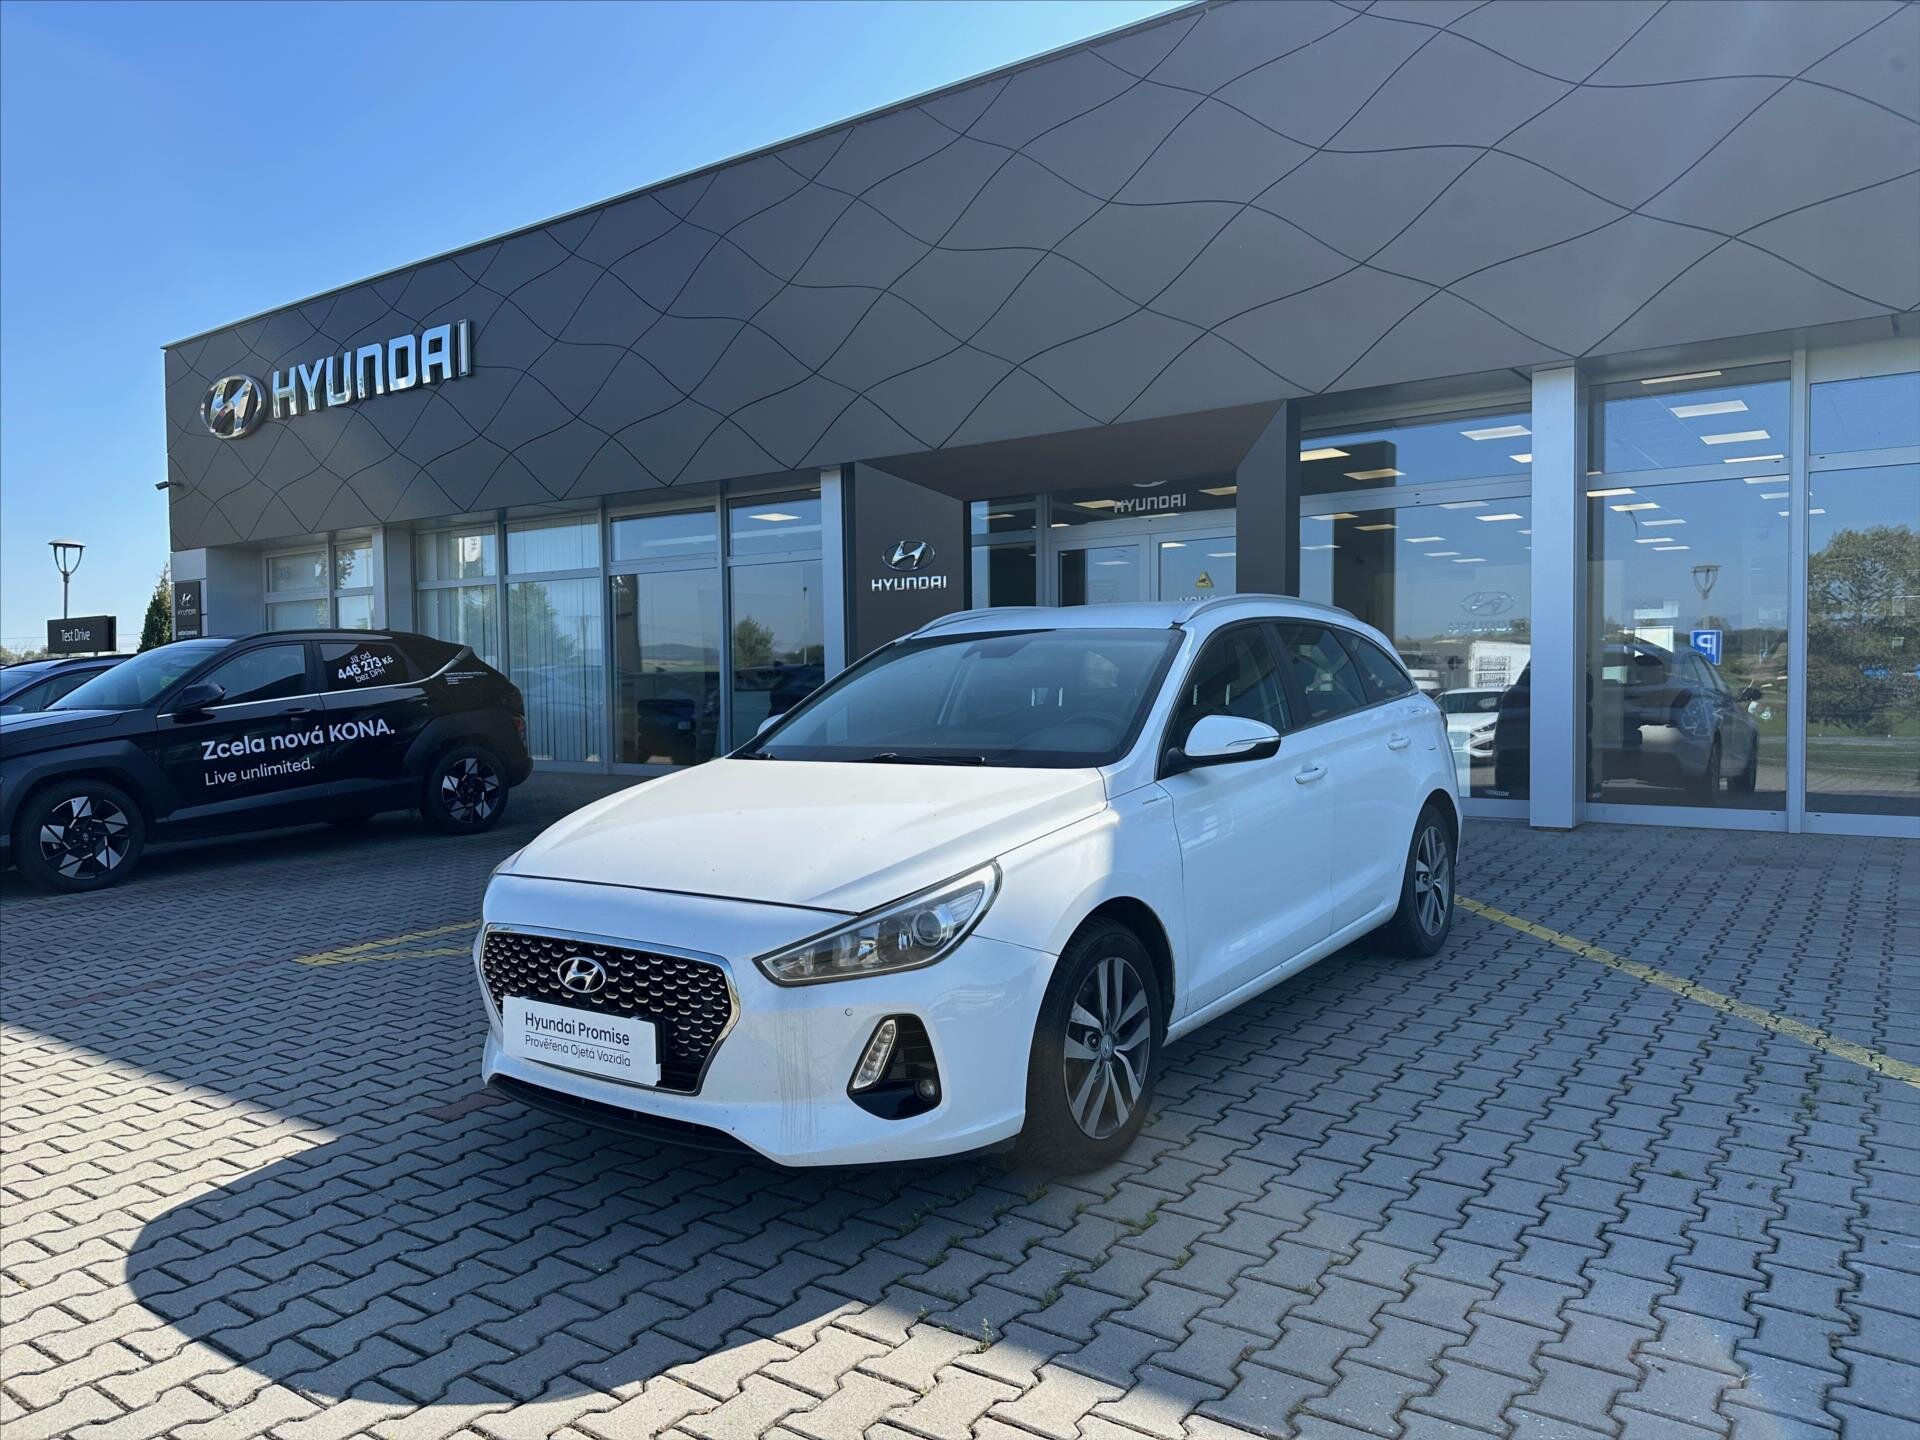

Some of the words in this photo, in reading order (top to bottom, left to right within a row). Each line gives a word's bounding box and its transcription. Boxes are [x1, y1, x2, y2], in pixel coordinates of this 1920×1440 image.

[271, 318, 471, 419] HYUNDAI
[1114, 493, 1187, 513] HYUNDAI
[871, 575, 947, 592] HYUNDAI
[60, 629, 73, 642] Test
[74, 628, 91, 641] Drive
[338, 663, 361, 679] 446
[361, 656, 382, 672] 273
[381, 655, 394, 665] Kč
[360, 651, 372, 660] od
[354, 673, 370, 683] bez
[369, 667, 386, 678] DPH
[201, 735, 266, 760] Zcela
[270, 725, 324, 750] nová
[328, 718, 396, 742] KONA.
[205, 770, 237, 786] Live
[241, 757, 315, 780] unlimited.
[525, 1011, 575, 1035] Hyundai
[578, 1022, 630, 1046] Promise
[525, 1034, 569, 1054] Prověřená
[570, 1043, 595, 1060] Ojetá
[596, 1049, 631, 1067] Vozidla
